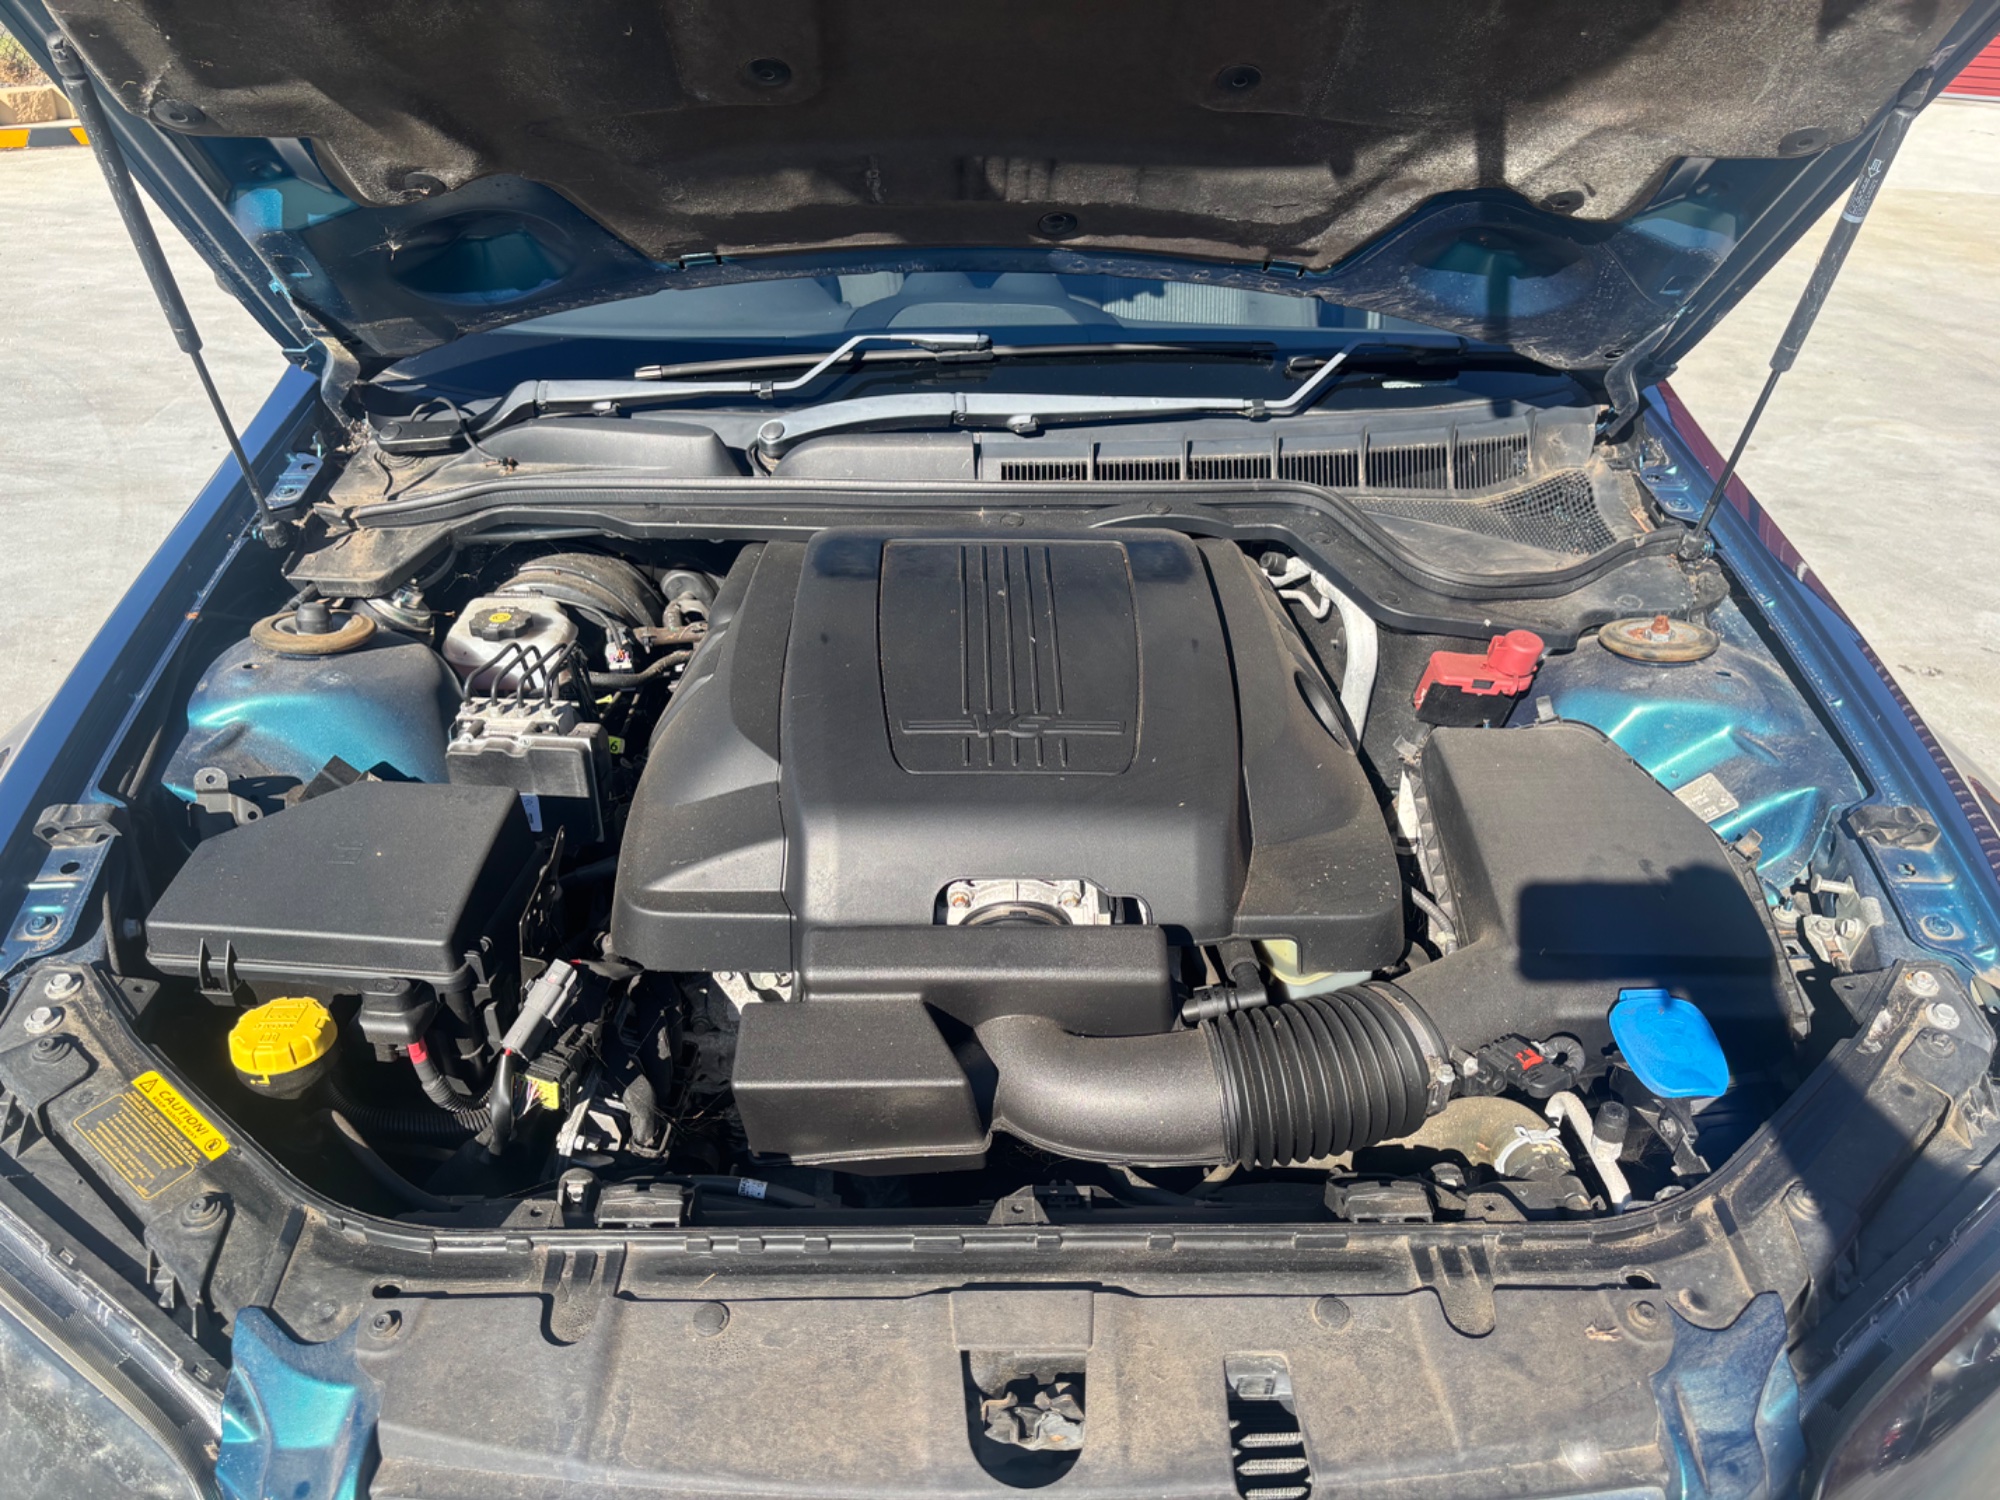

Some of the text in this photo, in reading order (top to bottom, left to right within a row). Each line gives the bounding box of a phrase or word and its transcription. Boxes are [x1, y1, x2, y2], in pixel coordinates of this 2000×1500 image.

[973, 714, 1054, 738] V6
[610, 741, 618, 751] 6
[152, 1096, 199, 1140] KEEP HANDS AWAY
[159, 1091, 209, 1135] CAUTION!
